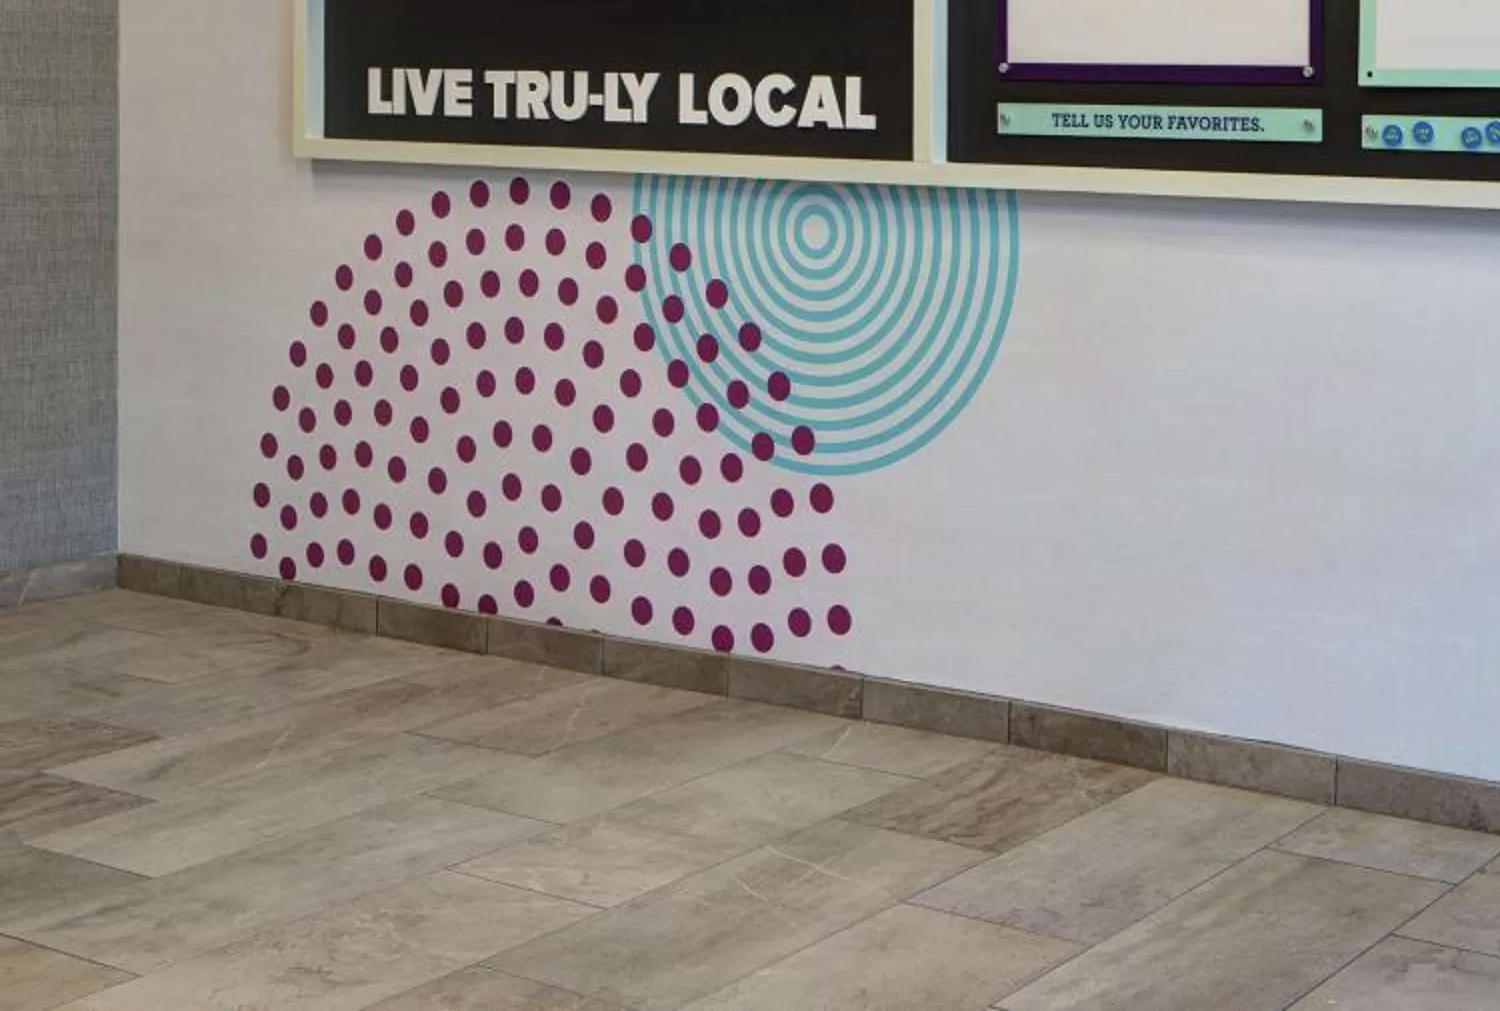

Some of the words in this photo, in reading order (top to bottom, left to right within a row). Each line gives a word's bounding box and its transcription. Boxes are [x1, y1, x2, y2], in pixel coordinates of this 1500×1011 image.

[367, 67, 474, 119] LIVE
[484, 70, 660, 124] TRU-LY
[678, 72, 878, 131] LOCAL
[1052, 113, 1090, 129] TELL
[1093, 114, 1114, 130] US
[1118, 114, 1164, 131] YOUR
[1167, 115, 1265, 132] FAVORITES.
